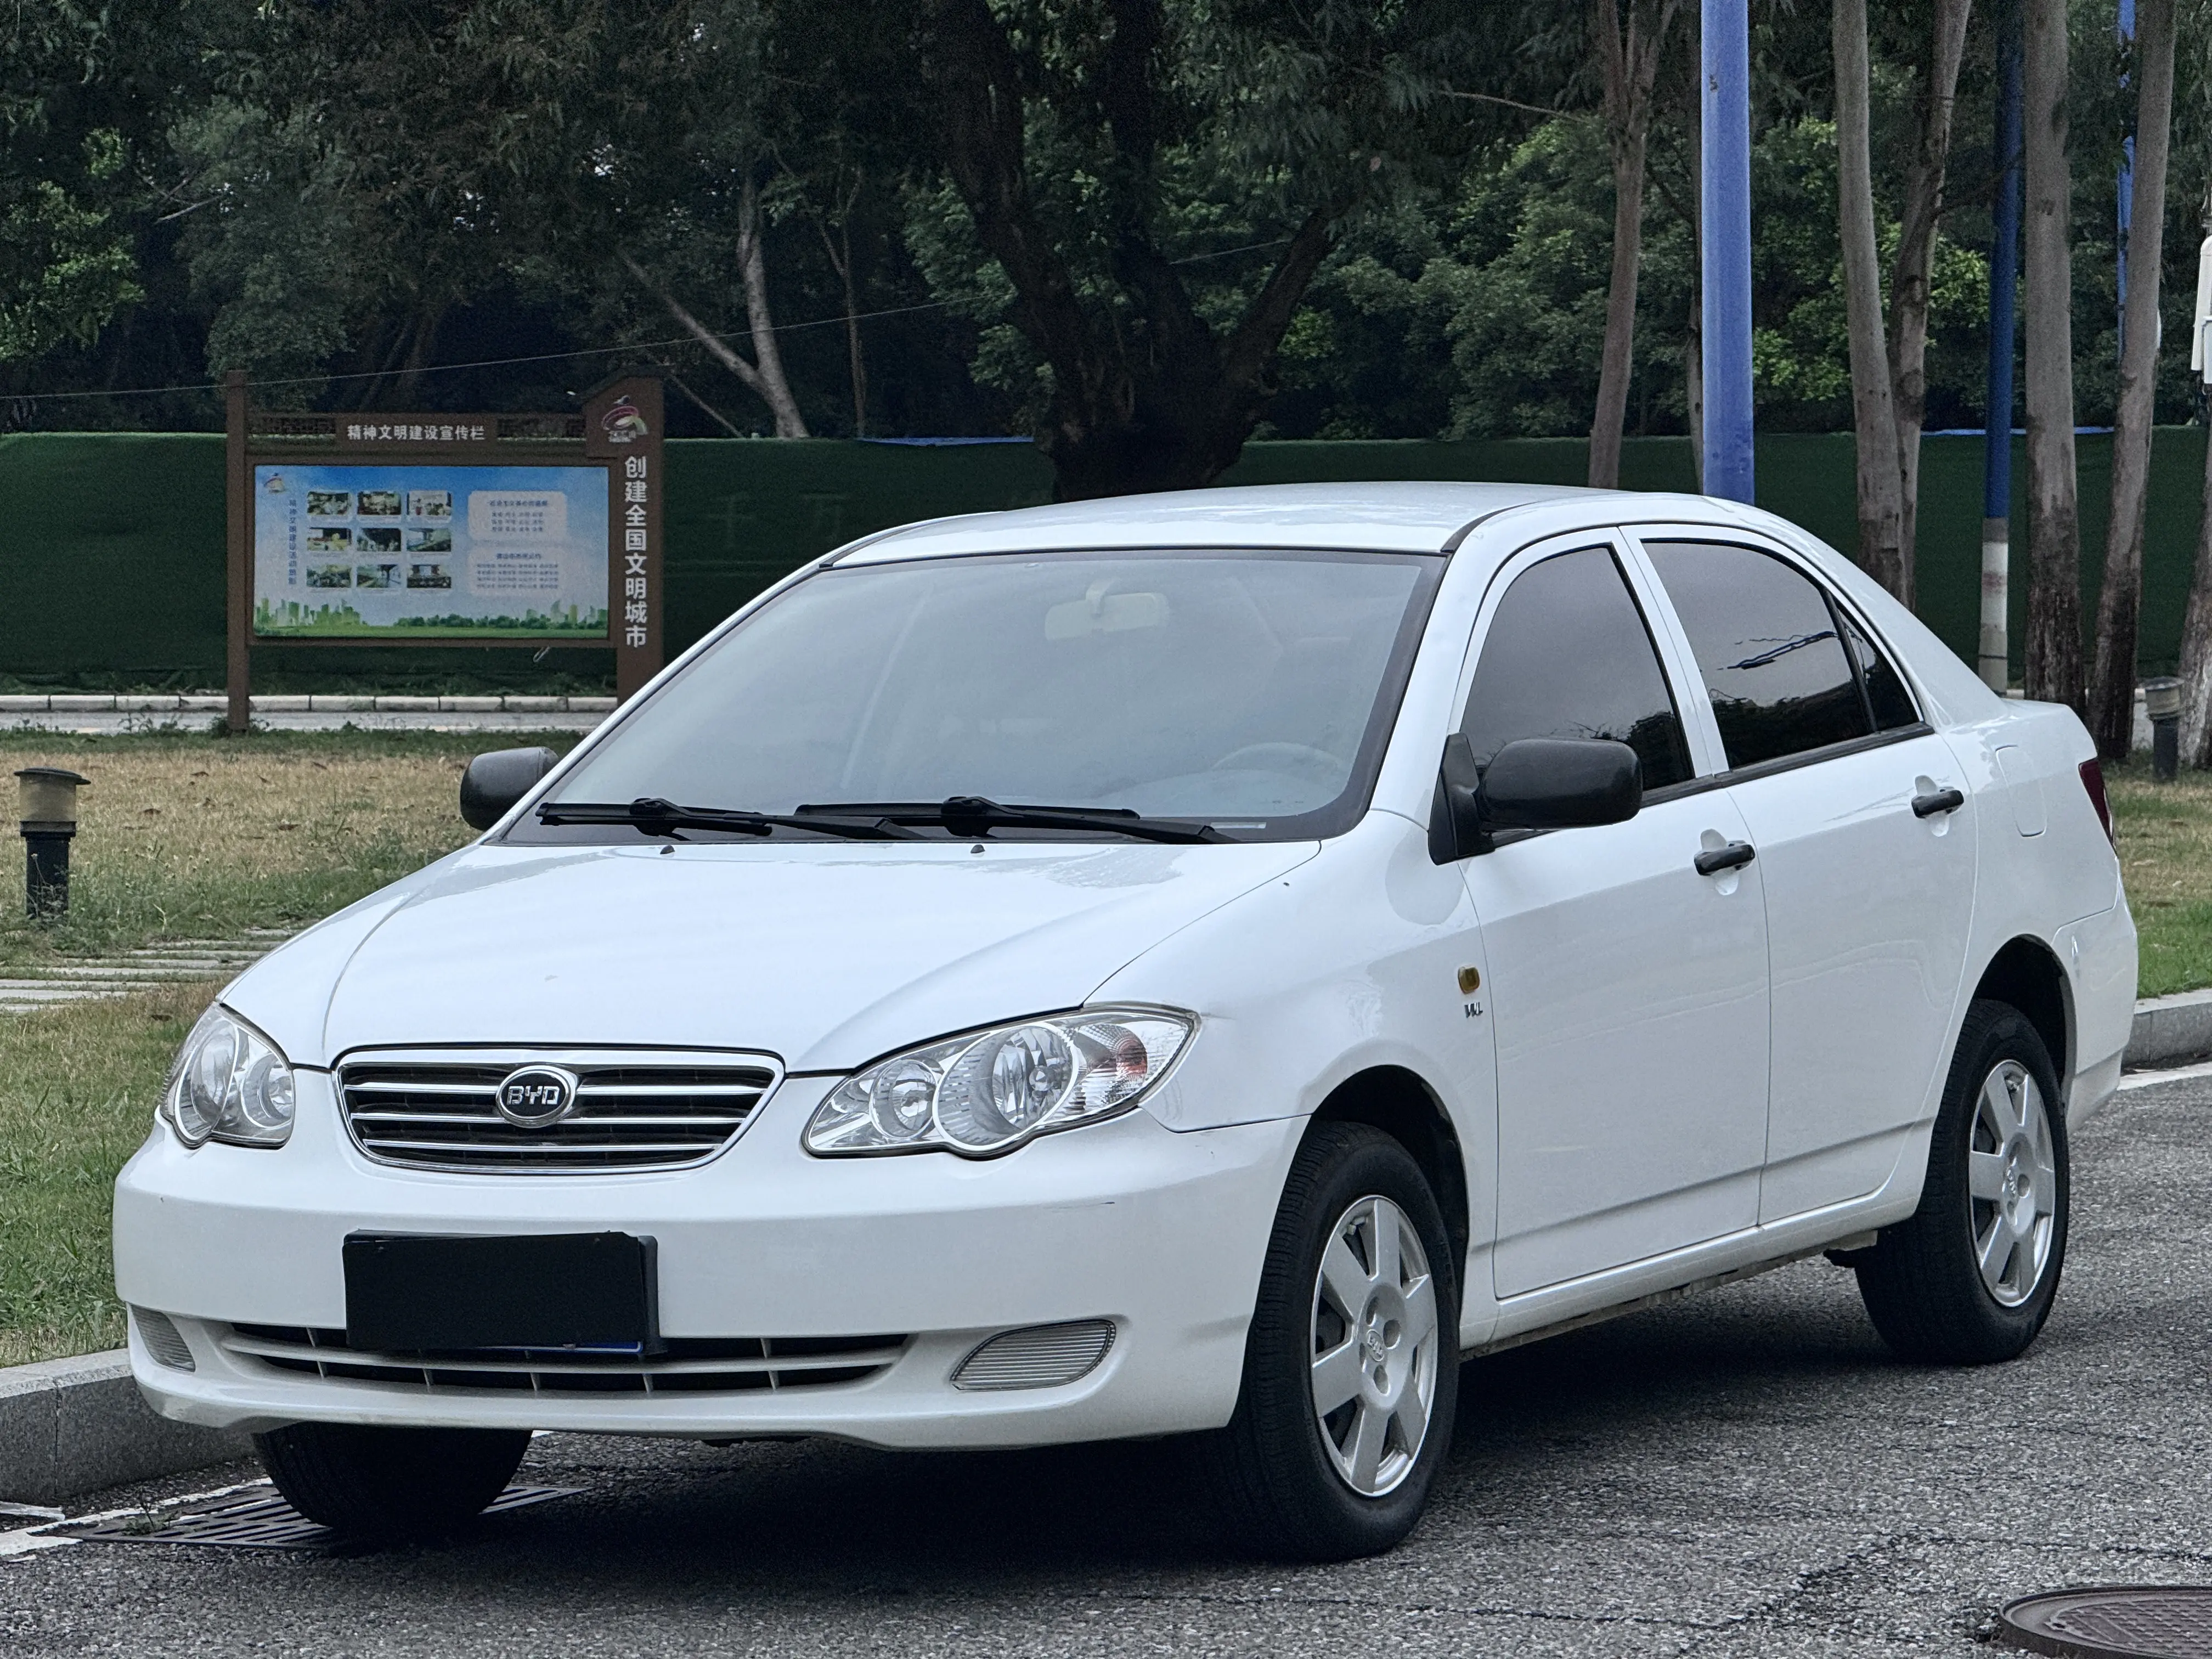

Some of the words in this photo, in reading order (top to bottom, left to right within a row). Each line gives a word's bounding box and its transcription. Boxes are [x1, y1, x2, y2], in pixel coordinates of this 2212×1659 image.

[347, 425, 485, 440] 精神文明建设宣传栏
[624, 456, 647, 647] 创建全国文明城市
[506, 1085, 560, 1105] BYD
